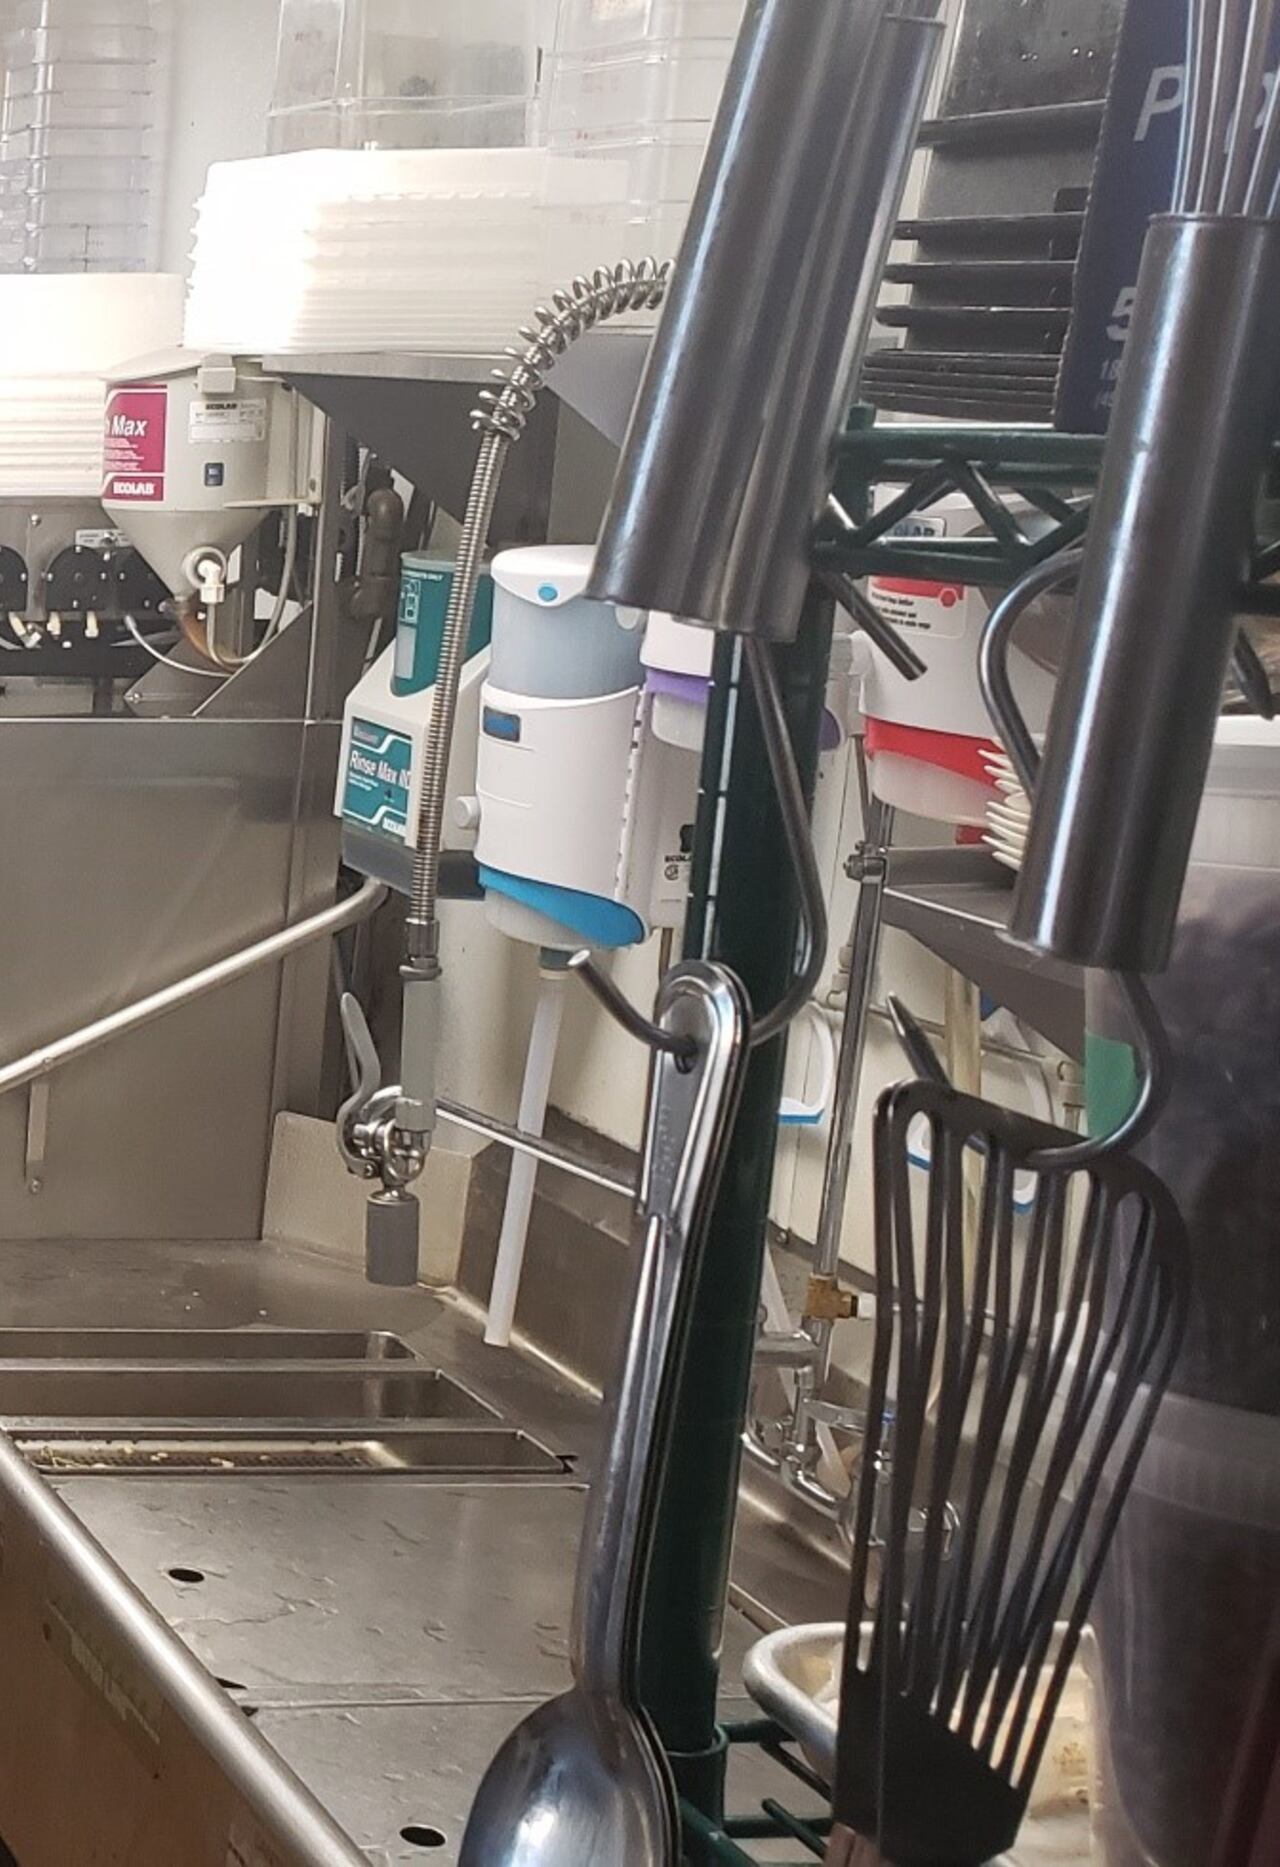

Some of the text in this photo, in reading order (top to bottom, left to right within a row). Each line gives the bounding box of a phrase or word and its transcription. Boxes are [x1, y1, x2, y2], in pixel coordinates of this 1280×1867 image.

[205, 402, 238, 410] ECOLAB
[111, 415, 148, 437] Max
[113, 481, 155, 495] ECOLAB
[349, 750, 377, 776] Rinse
[377, 760, 398, 785] Max
